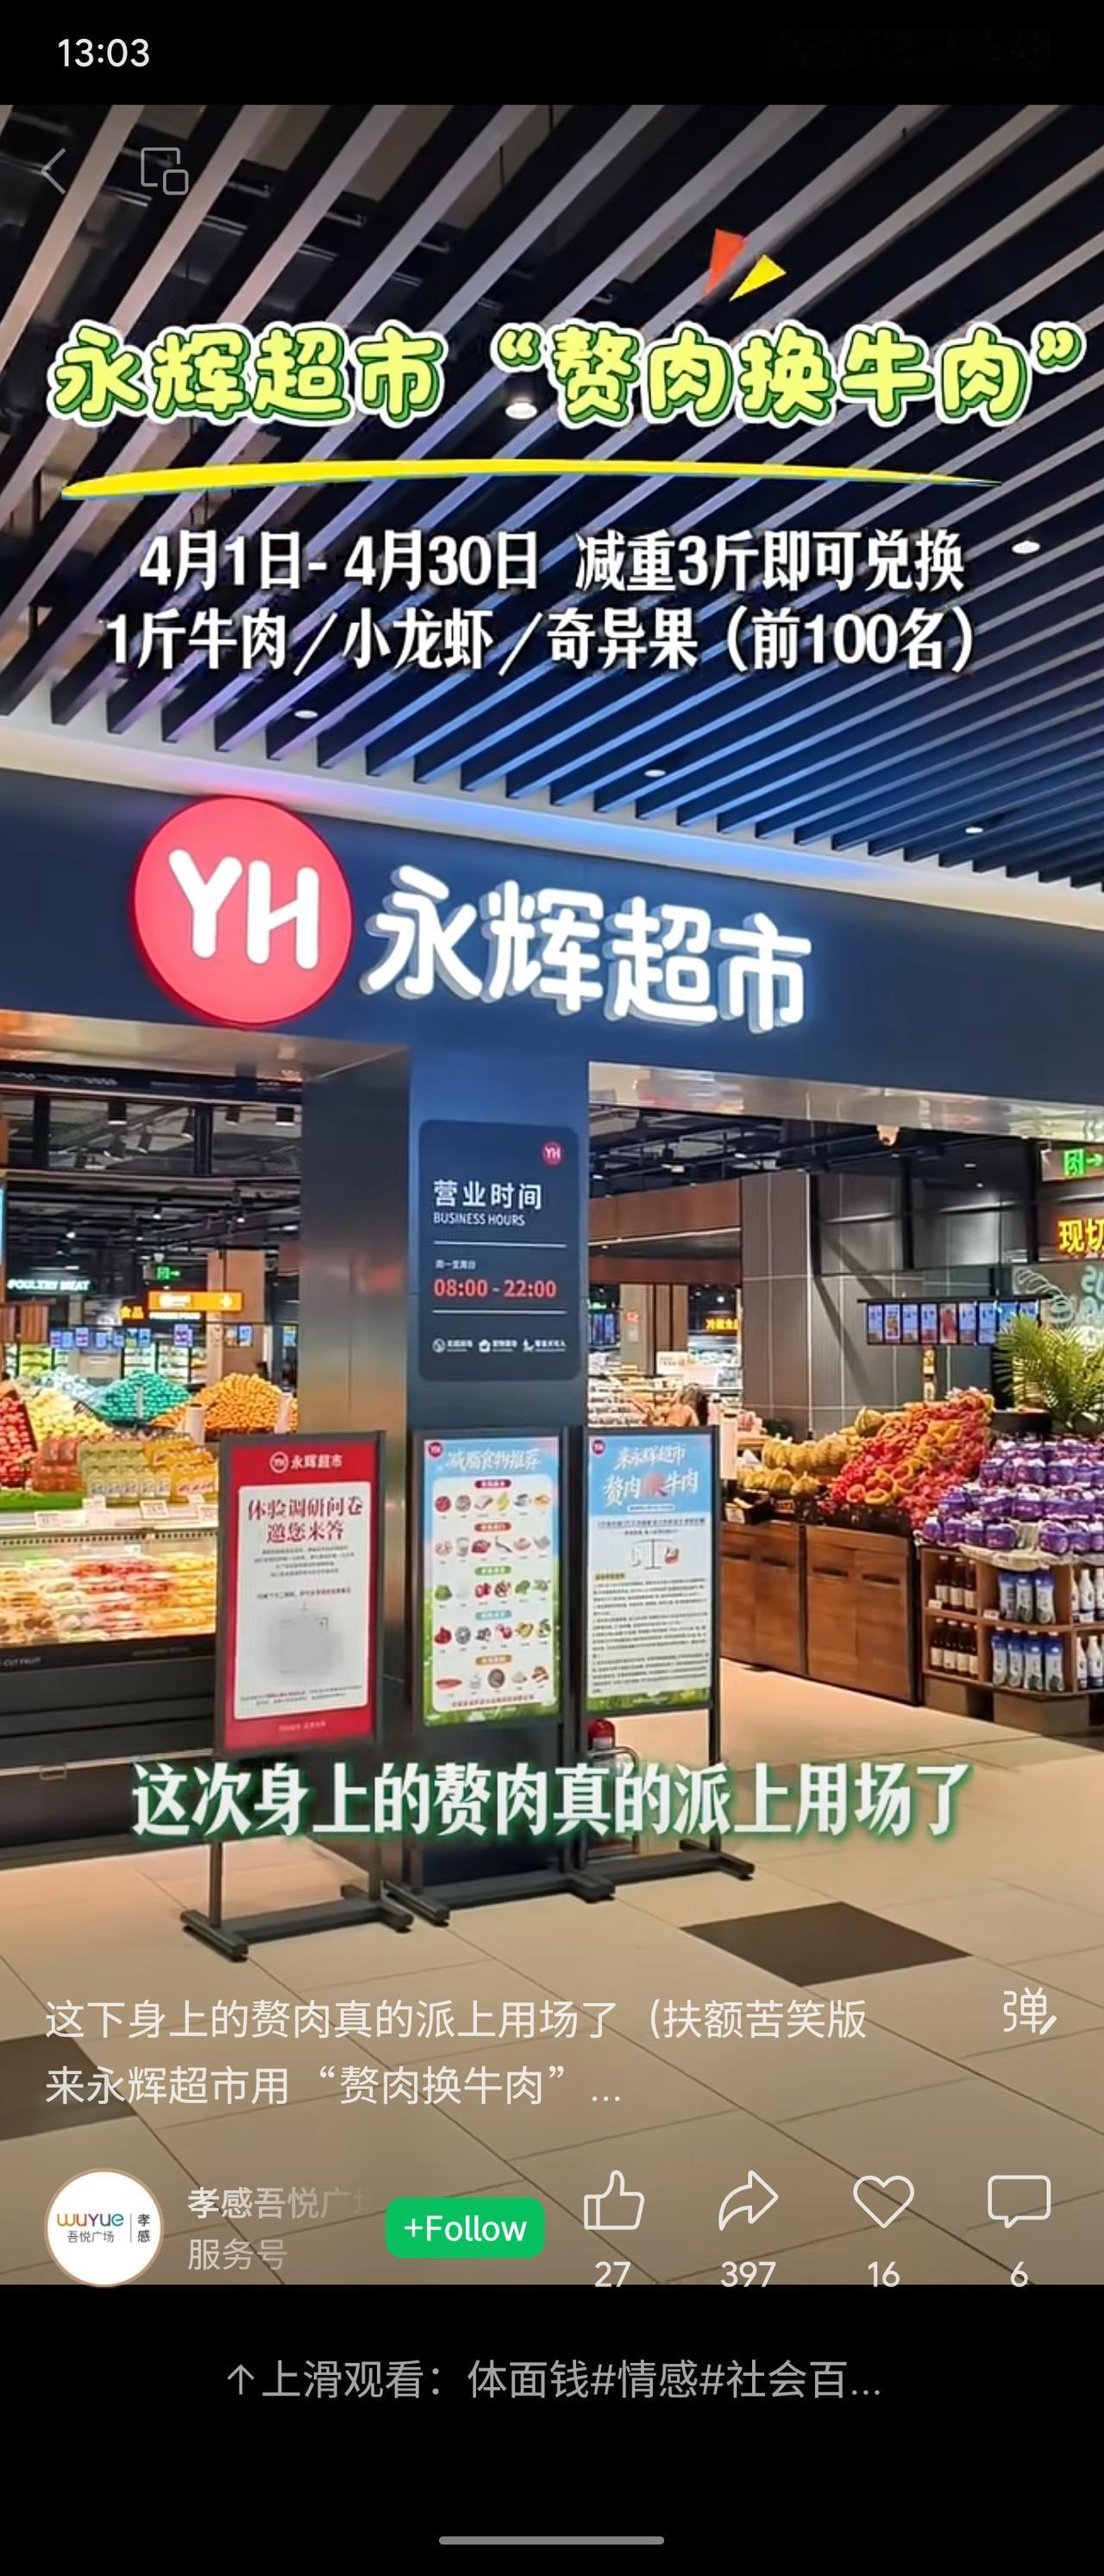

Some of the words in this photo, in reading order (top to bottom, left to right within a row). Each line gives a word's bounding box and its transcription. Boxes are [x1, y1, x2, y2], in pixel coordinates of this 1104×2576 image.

[168, 848, 320, 970] YH
[360, 864, 812, 1034] 永辉超市
[544, 1146, 561, 1160] YH
[434, 1178, 543, 1210] 营业时间
[434, 1213, 486, 1225] BUSINESS
[488, 1214, 526, 1226] HOURS
[434, 1279, 488, 1297] 08:00
[504, 1279, 557, 1298] 22:00
[291, 1453, 343, 1470] 永辉超市
[248, 1495, 363, 1521] 体验调研问卷
[267, 1520, 344, 1543] 邀您来答
